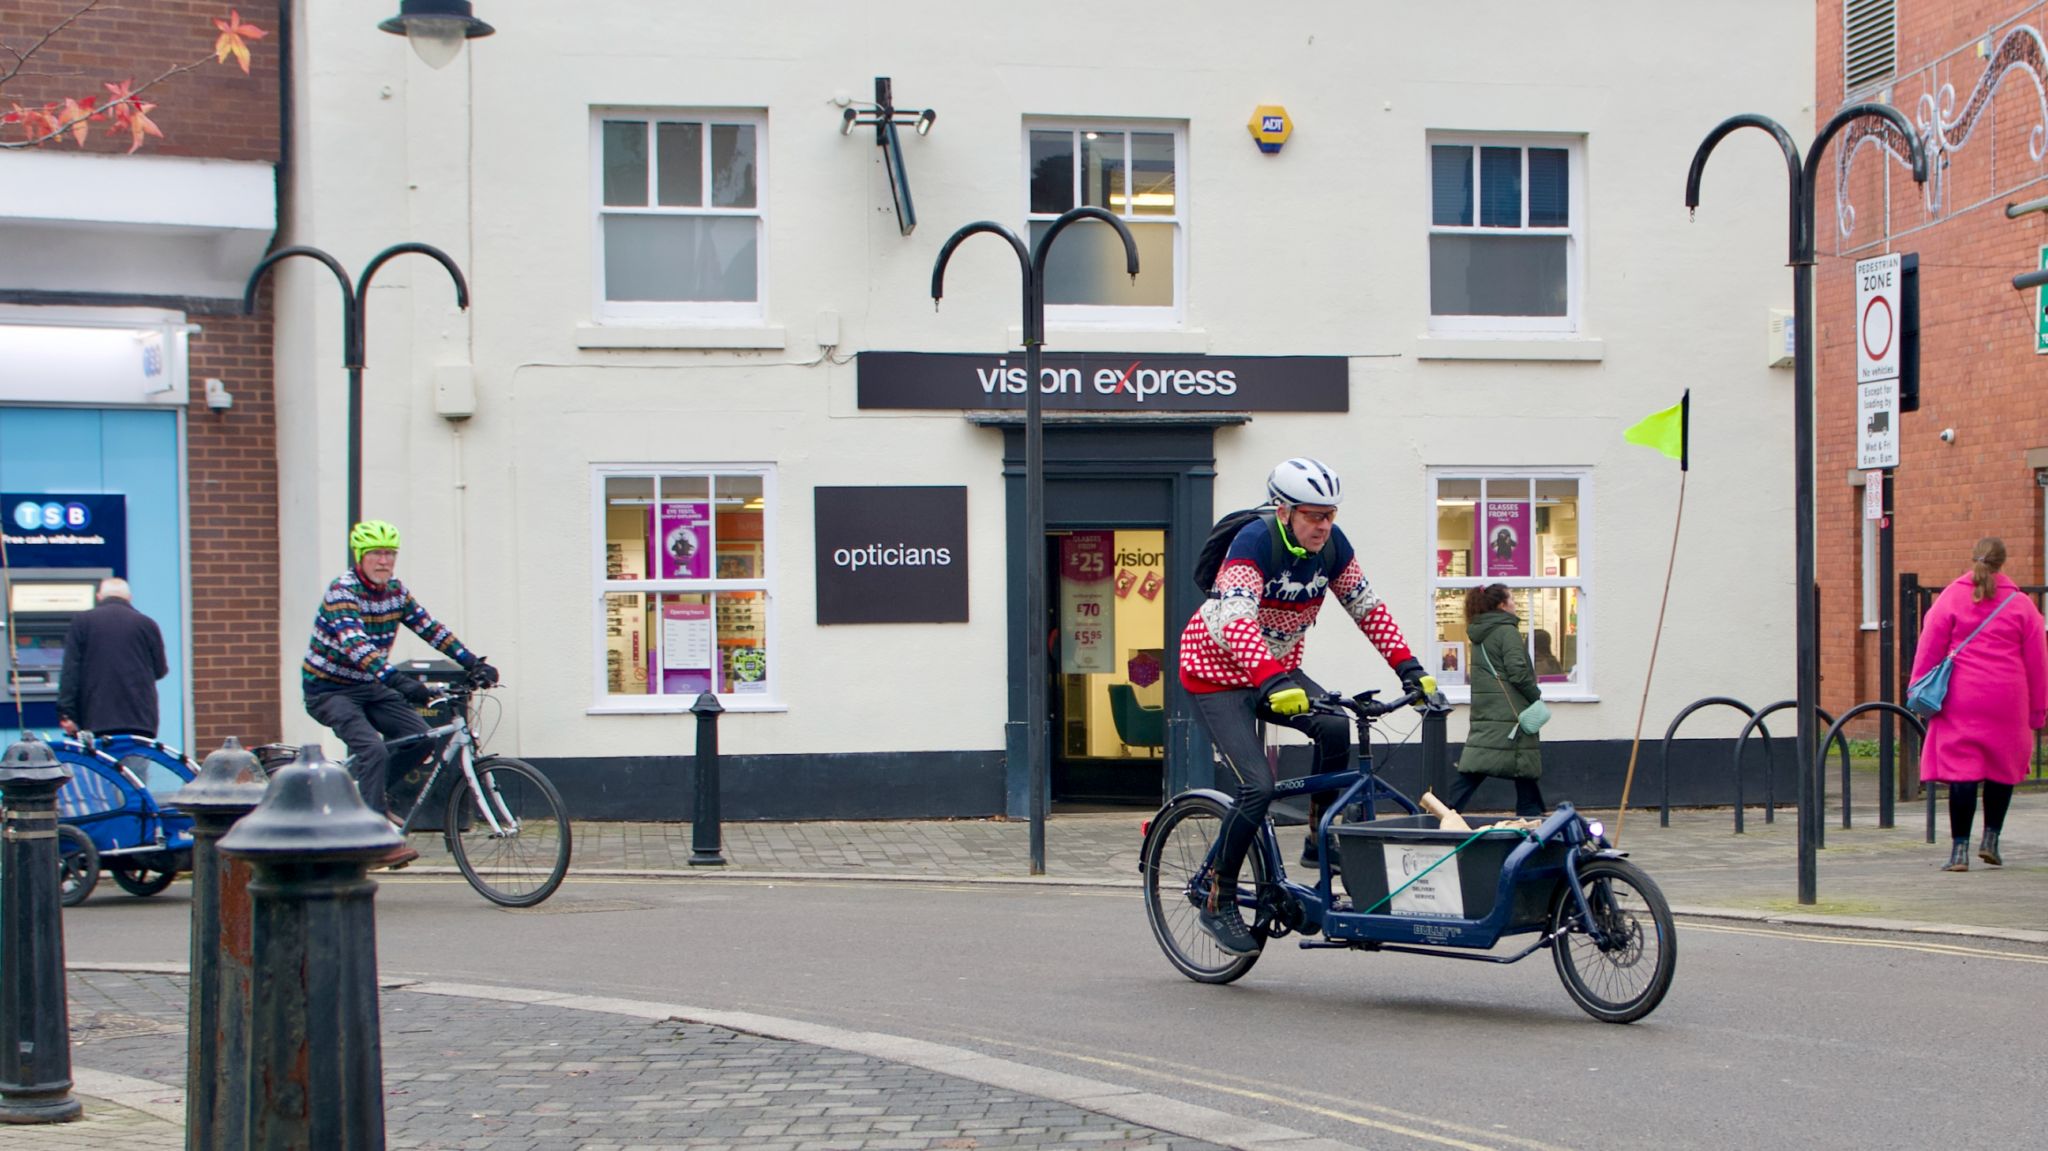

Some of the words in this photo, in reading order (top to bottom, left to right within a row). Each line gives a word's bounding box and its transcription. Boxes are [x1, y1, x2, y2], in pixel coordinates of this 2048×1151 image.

[1263, 118, 1283, 131] ADT
[1858, 258, 1899, 274] PEDESTRIAN
[1864, 272, 1892, 291] ZONE
[1862, 368, 1871, 377] No
[1872, 366, 1894, 376] vehicles
[976, 359, 1082, 394] vison
[1093, 361, 1237, 402] express
[1864, 386, 1883, 398] Except
[1884, 384, 1892, 394] for
[1864, 399, 1884, 409] loading
[1885, 398, 1892, 408] by
[1865, 442, 1877, 452] Wed
[1883, 440, 1892, 450] Fri
[1488, 503, 1519, 511] GLASSES
[21, 506, 86, 525] TSB
[25, 534, 48, 545] cash
[48, 534, 105, 545] withdrawals
[833, 542, 951, 571] opticians
[1070, 552, 1105, 572] £25
[1076, 602, 1100, 617] £70
[415, 707, 438, 717] itter
